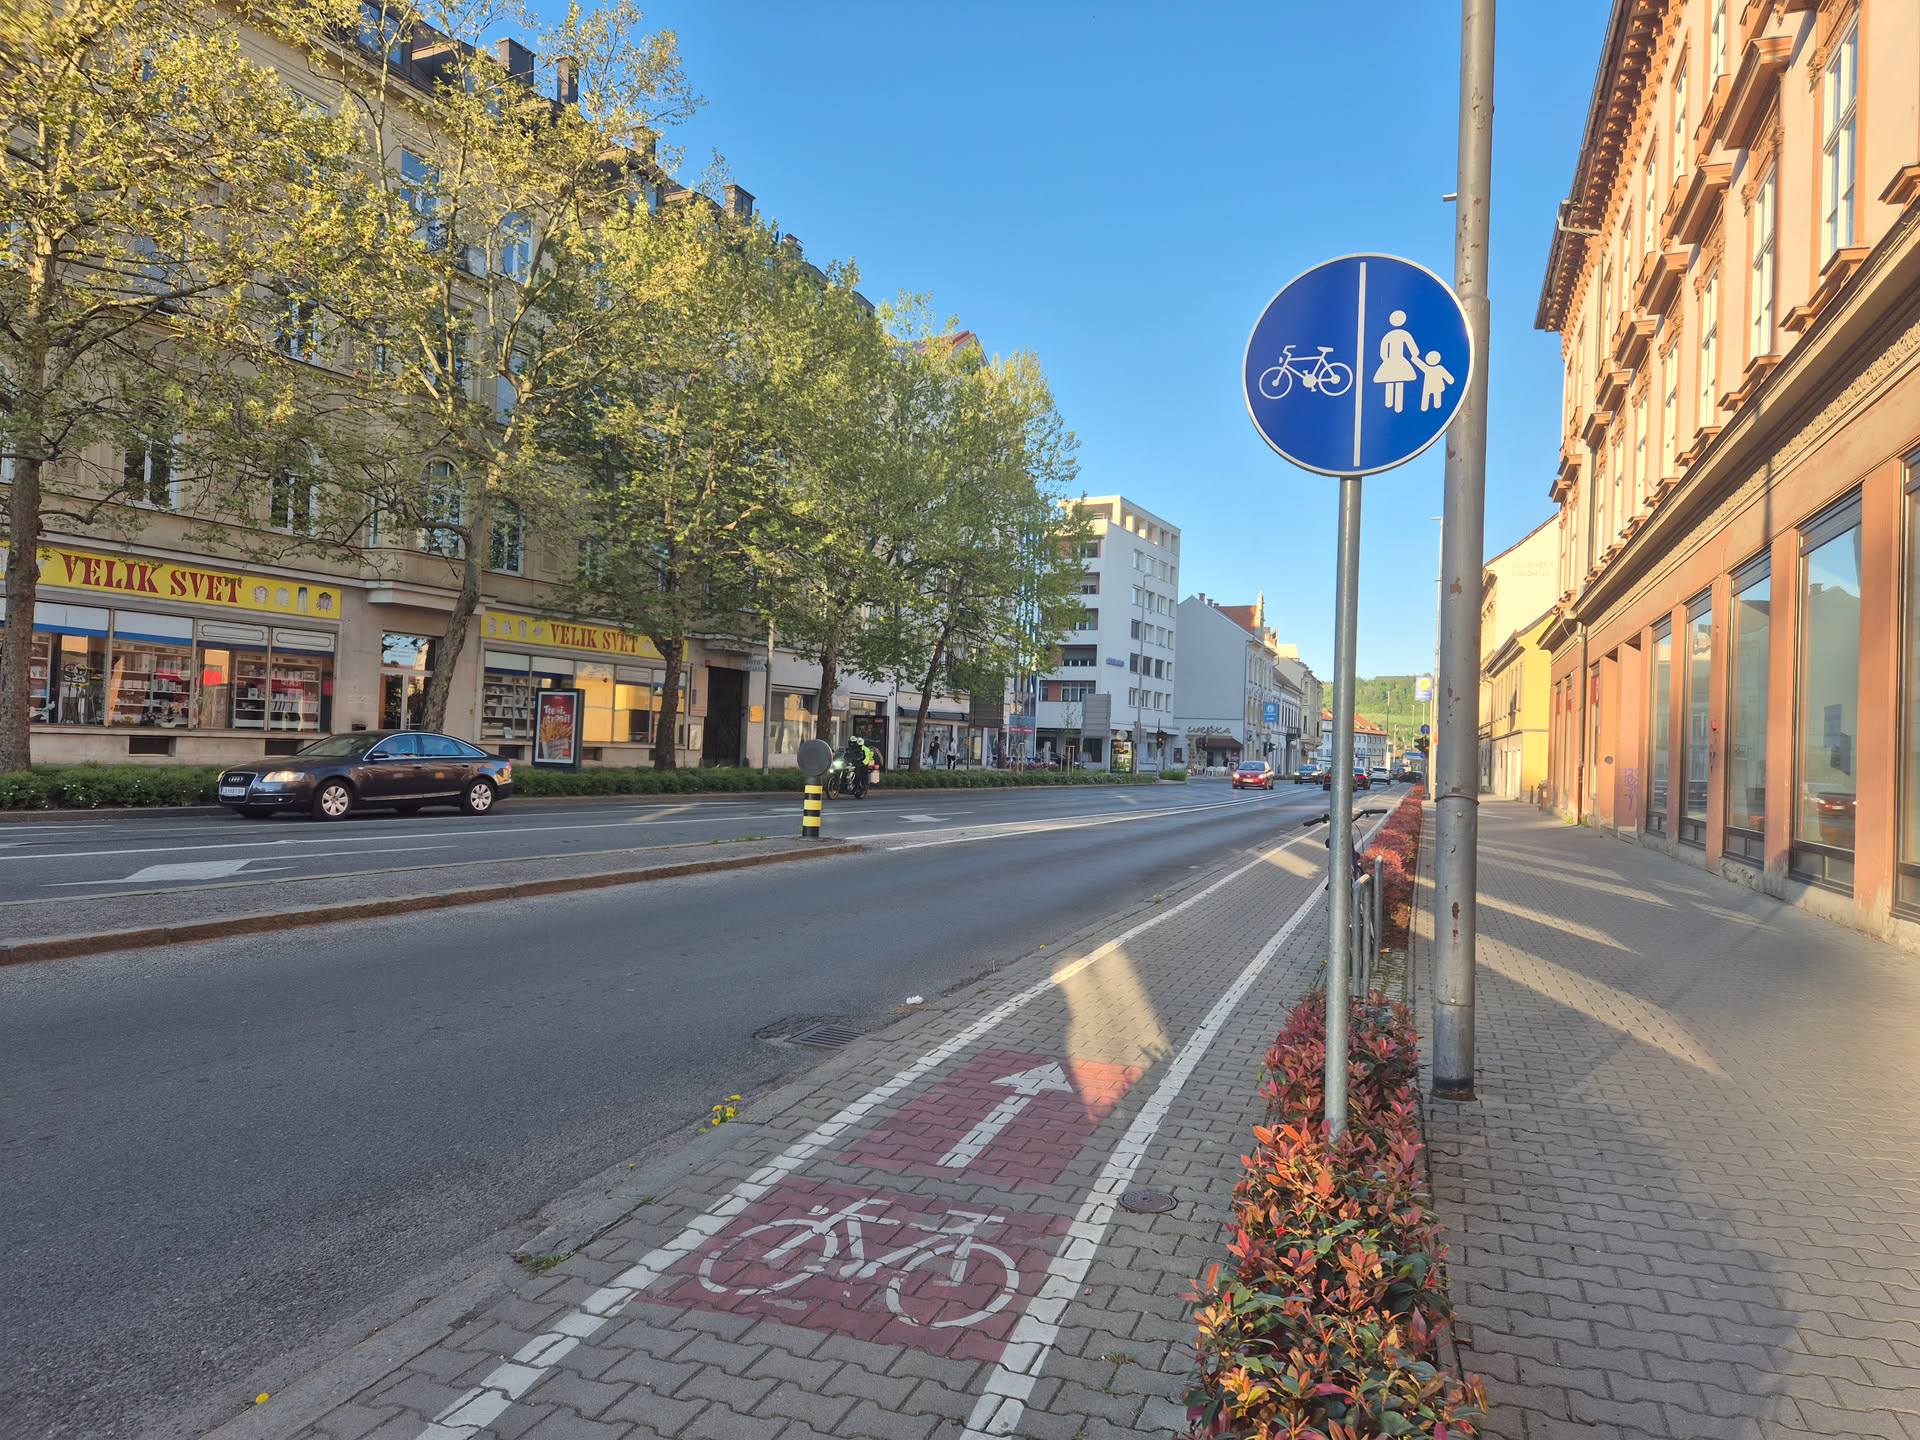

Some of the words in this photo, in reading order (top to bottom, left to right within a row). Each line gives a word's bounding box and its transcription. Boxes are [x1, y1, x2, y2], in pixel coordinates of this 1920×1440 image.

[63, 554, 159, 593] VELIK
[170, 570, 242, 603] SVET
[551, 623, 597, 648] VELIK
[603, 631, 638, 653] SVET
